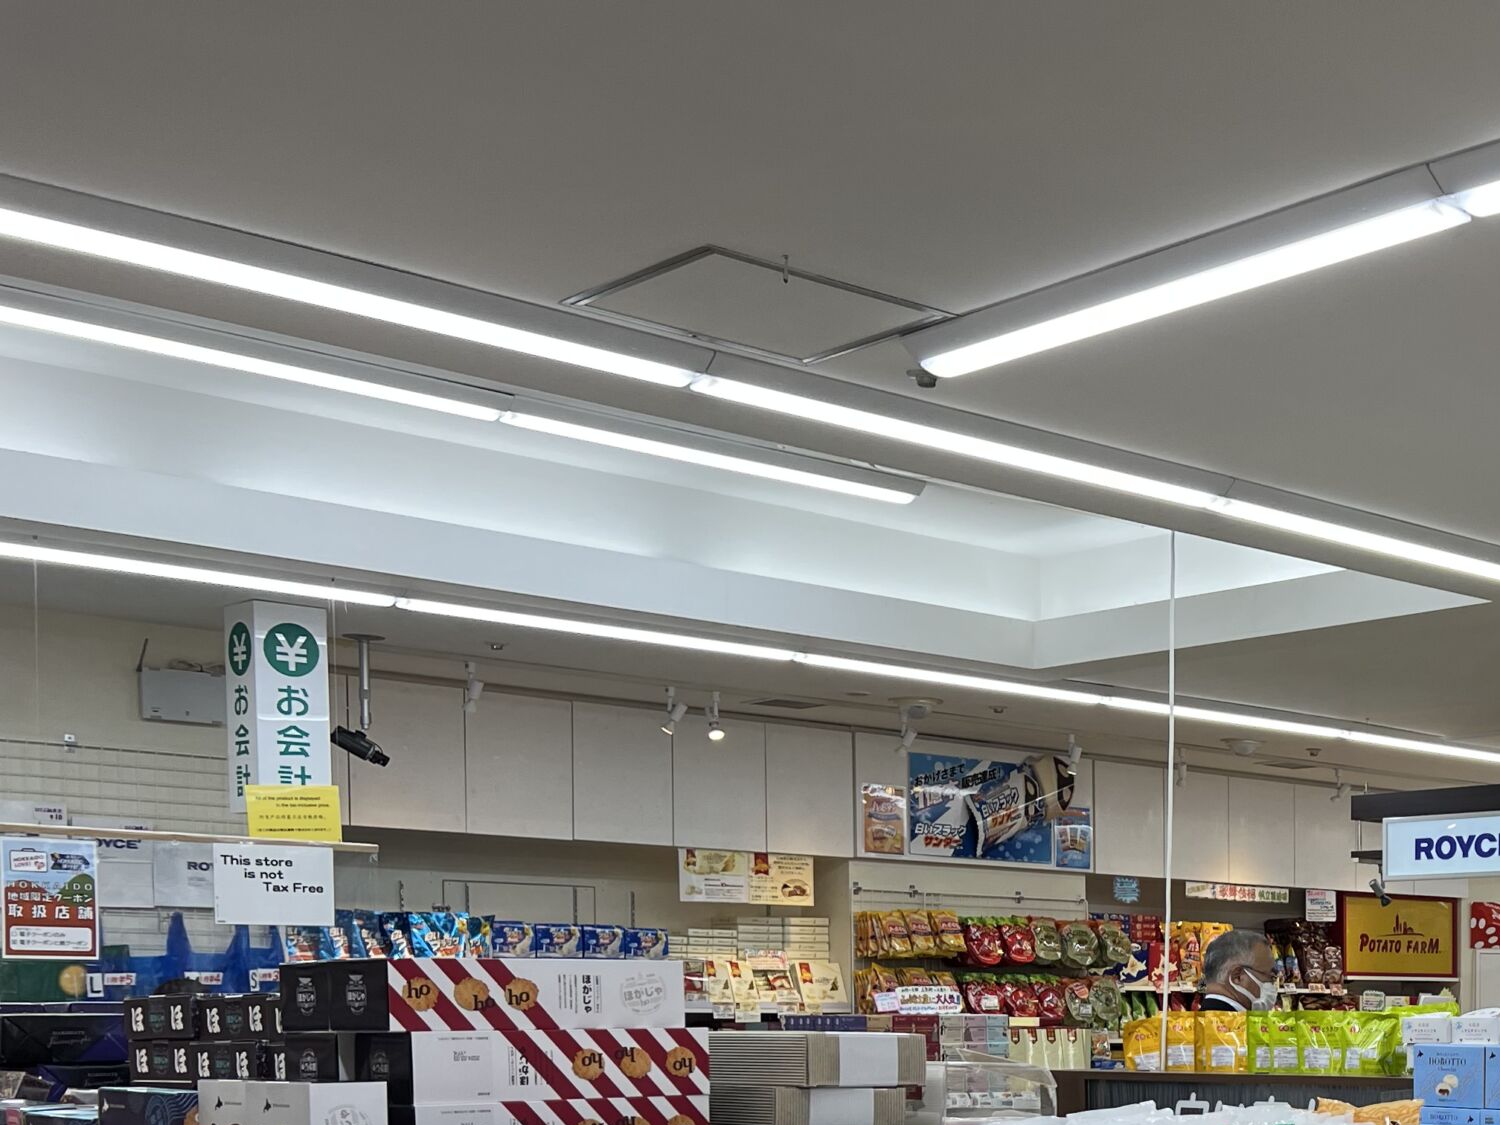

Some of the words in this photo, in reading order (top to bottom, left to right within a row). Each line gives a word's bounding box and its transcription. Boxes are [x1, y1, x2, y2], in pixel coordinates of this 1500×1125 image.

[914, 823, 967, 836] 白いブラック
[220, 854, 251, 866] This
[255, 856, 293, 868] store
[244, 868, 256, 879] is
[259, 870, 284, 880] not
[262, 882, 289, 893] Tax
[293, 883, 324, 894] Free
[7, 904, 94, 920] 取扱店舗
[1358, 934, 1402, 954] POTATO
[1406, 936, 1441, 955] FARM
[406, 977, 431, 999] ho
[506, 988, 531, 1006] ho
[1428, 1057, 1467, 1066] HOROTTO
